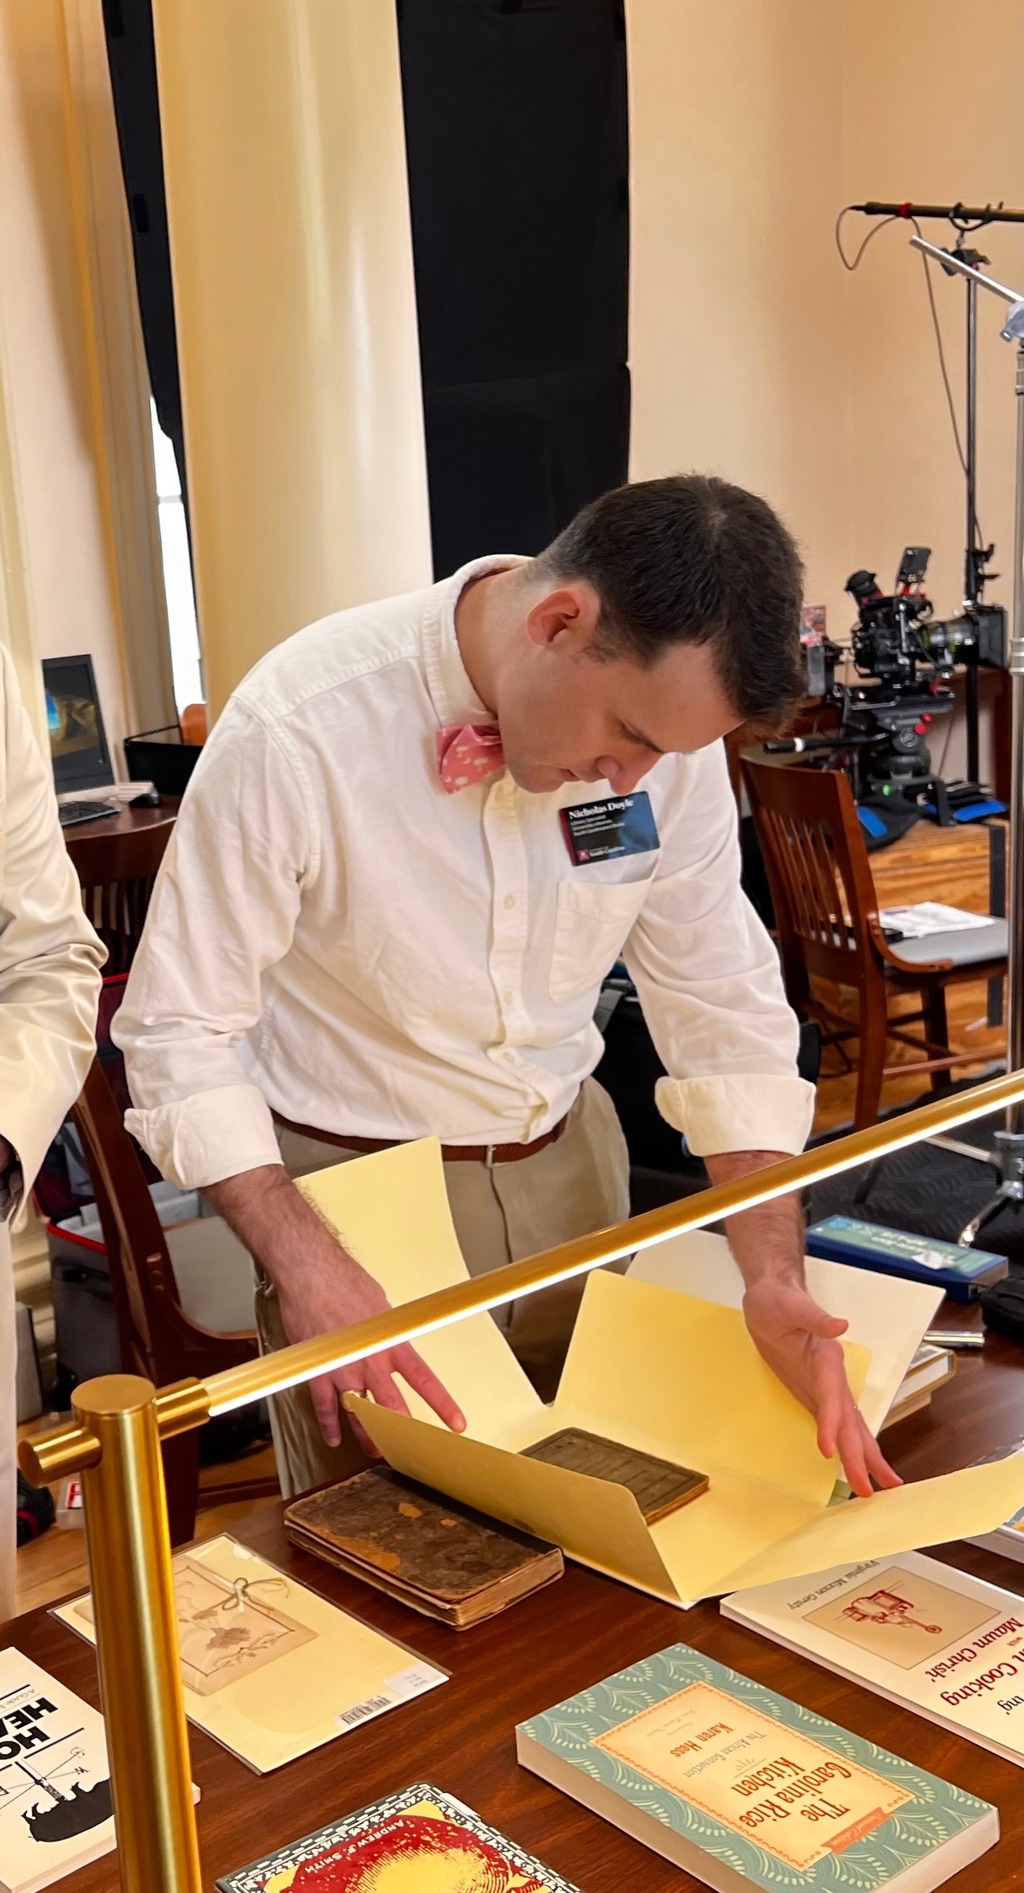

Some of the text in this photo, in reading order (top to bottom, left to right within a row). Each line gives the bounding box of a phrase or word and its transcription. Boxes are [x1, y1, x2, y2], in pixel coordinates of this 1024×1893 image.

[569, 799, 634, 819] Nicholas Doyle
[845, 1559, 880, 1579] Virginia
[972, 1618, 1023, 1649] Maum
[940, 1663, 1018, 1707] Cooking
[6, 1692, 29, 1705] Guide
[696, 1721, 734, 1742] Karen
[670, 1739, 702, 1757] Hess
[683, 1730, 767, 1777] The African Connection
[731, 1756, 806, 1797] Kitchen
[739, 1762, 852, 1826] Carolina Rice
[801, 1798, 851, 1822] The
[357, 1818, 405, 1846] ANDREW
[305, 1851, 343, 1872] SMITH
